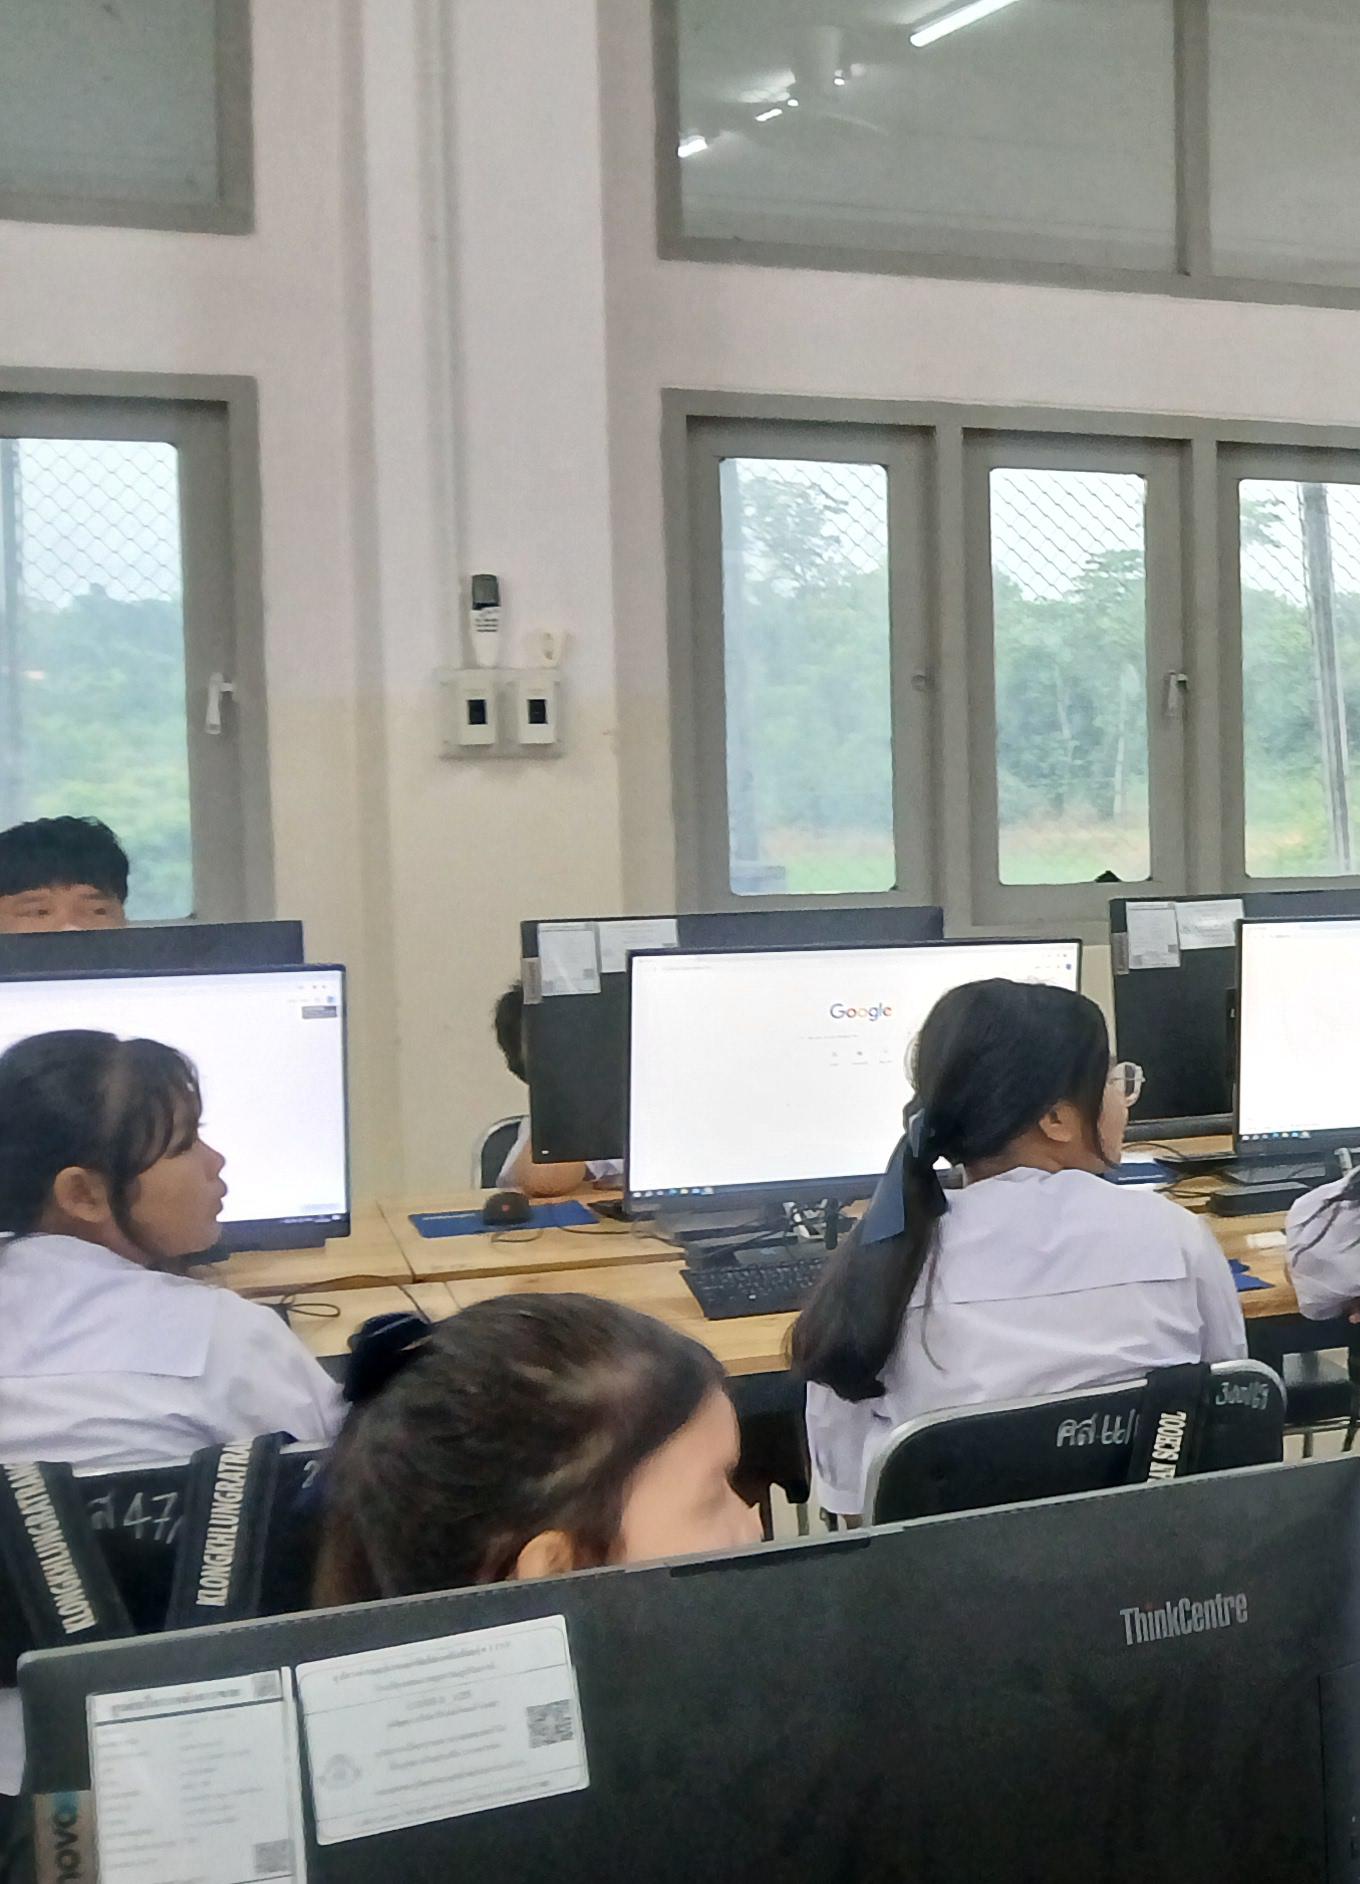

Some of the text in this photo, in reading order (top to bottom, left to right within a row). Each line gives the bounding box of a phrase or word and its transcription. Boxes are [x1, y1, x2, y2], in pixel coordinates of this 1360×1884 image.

[830, 1003, 892, 1022] Google
[1152, 1410, 1187, 1461] SCHOOL
[1119, 1592, 1248, 1646] ThinkCentre
